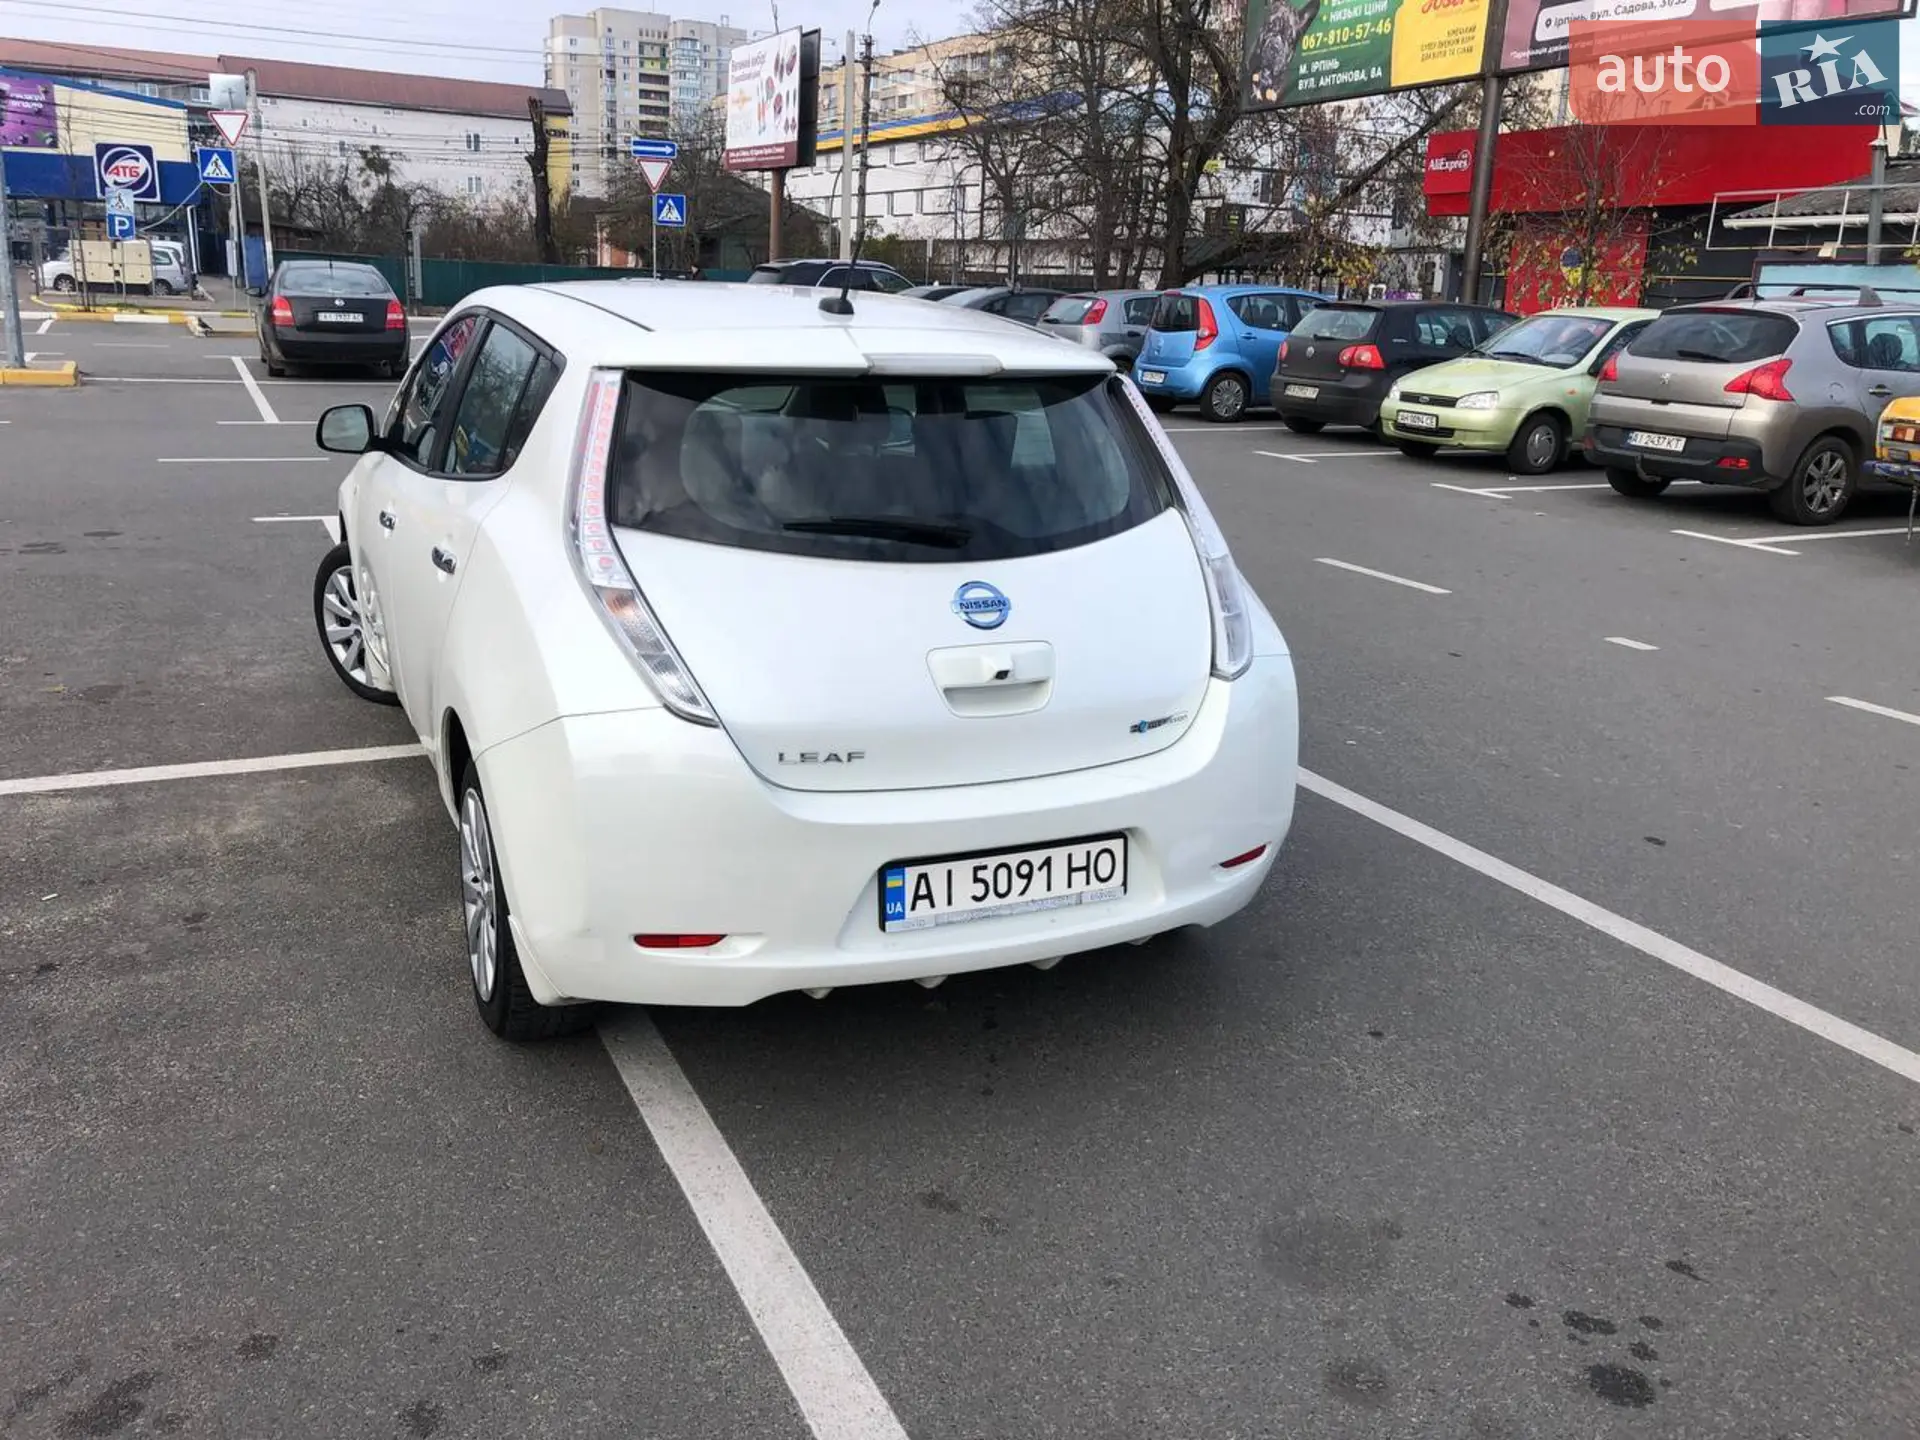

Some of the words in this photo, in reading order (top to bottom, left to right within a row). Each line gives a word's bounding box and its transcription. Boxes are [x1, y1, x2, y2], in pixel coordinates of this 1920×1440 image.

[1302, 19, 1391, 50] 067-810-57-46
[1319, 68, 1369, 87] АНТОНОВА,
[108, 165, 140, 178] АТБ
[115, 217, 129, 237] P
[959, 599, 1008, 610] NISSAN
[778, 751, 865, 765] LEAF
[910, 872, 953, 912] AI
[971, 856, 1053, 902] 5091
[1066, 847, 1117, 889] HO
[886, 902, 904, 914] UA
